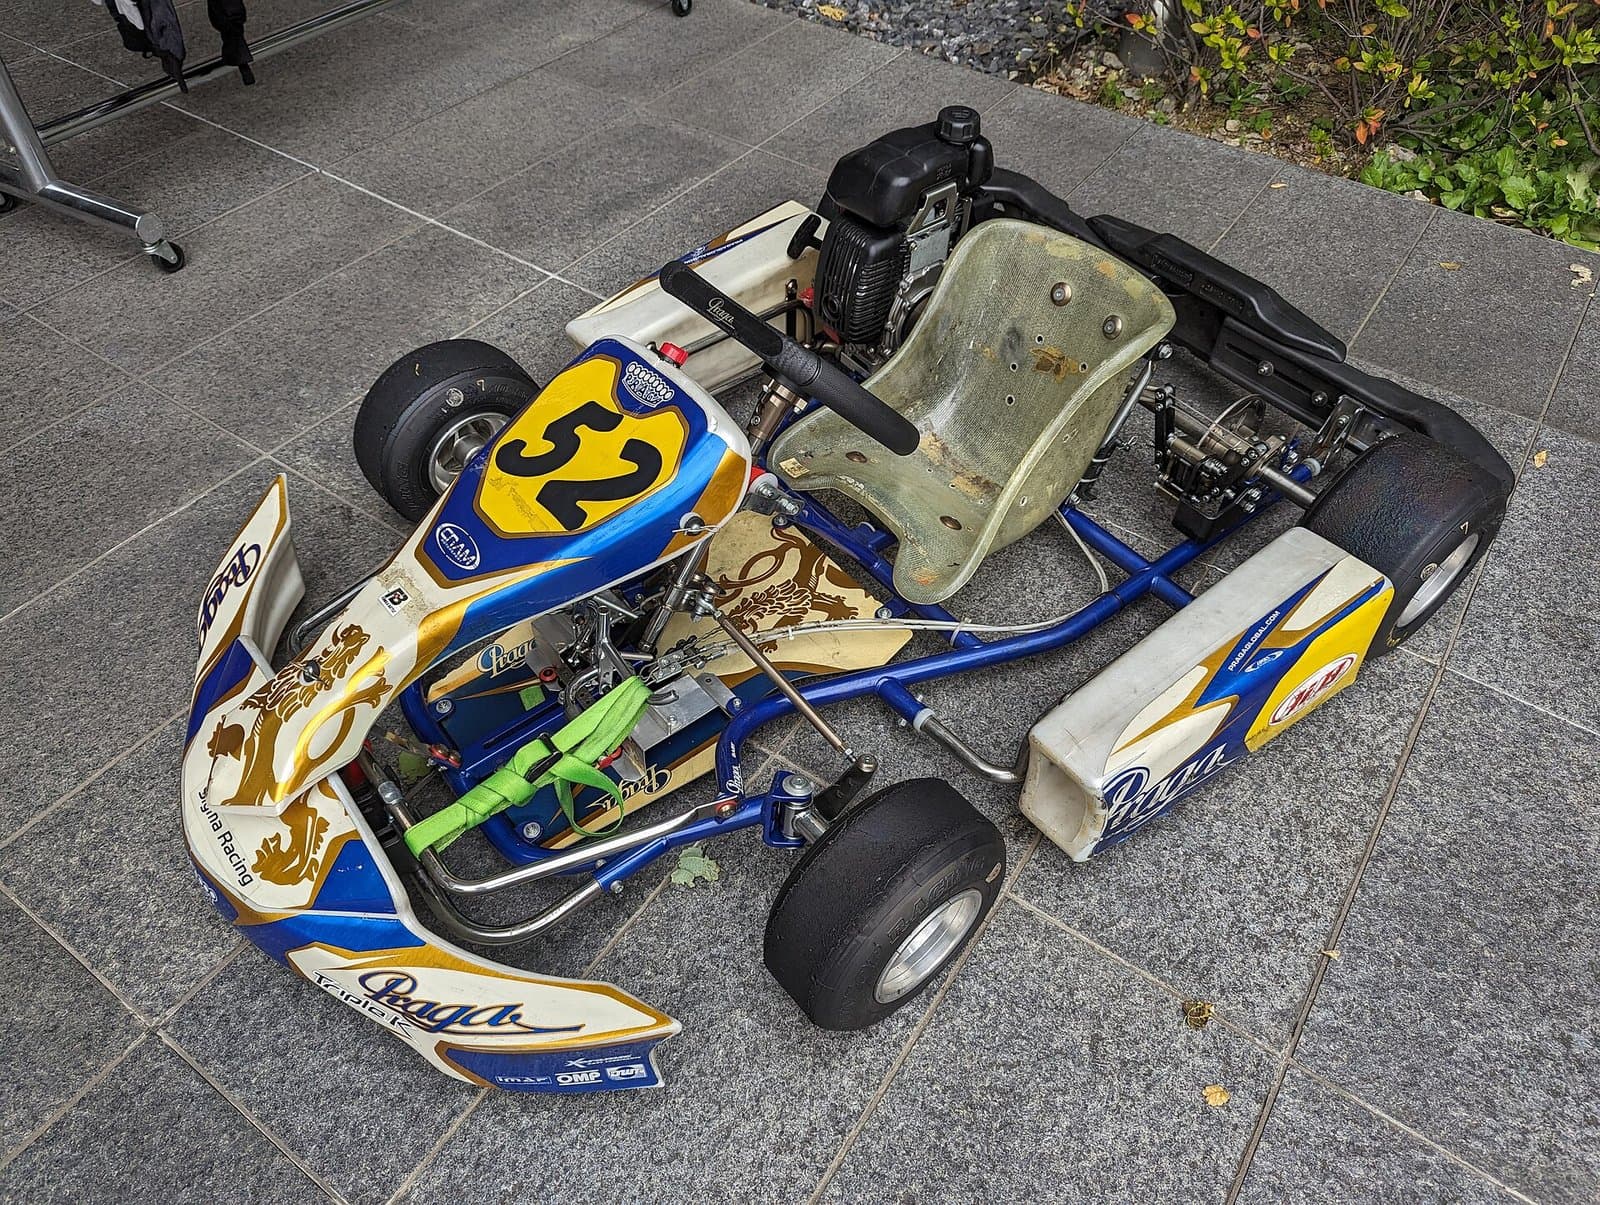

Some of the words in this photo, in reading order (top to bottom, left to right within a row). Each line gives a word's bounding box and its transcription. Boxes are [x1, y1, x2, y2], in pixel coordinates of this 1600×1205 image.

[708, 297, 736, 330] Praga
[495, 400, 663, 532] 52
[1227, 610, 1281, 672] PRAGAGLOBAL.COM
[1101, 743, 1240, 842] Praga
[217, 830, 254, 887] Racing
[358, 970, 586, 1035] Praga
[556, 1071, 601, 1083] OMP
